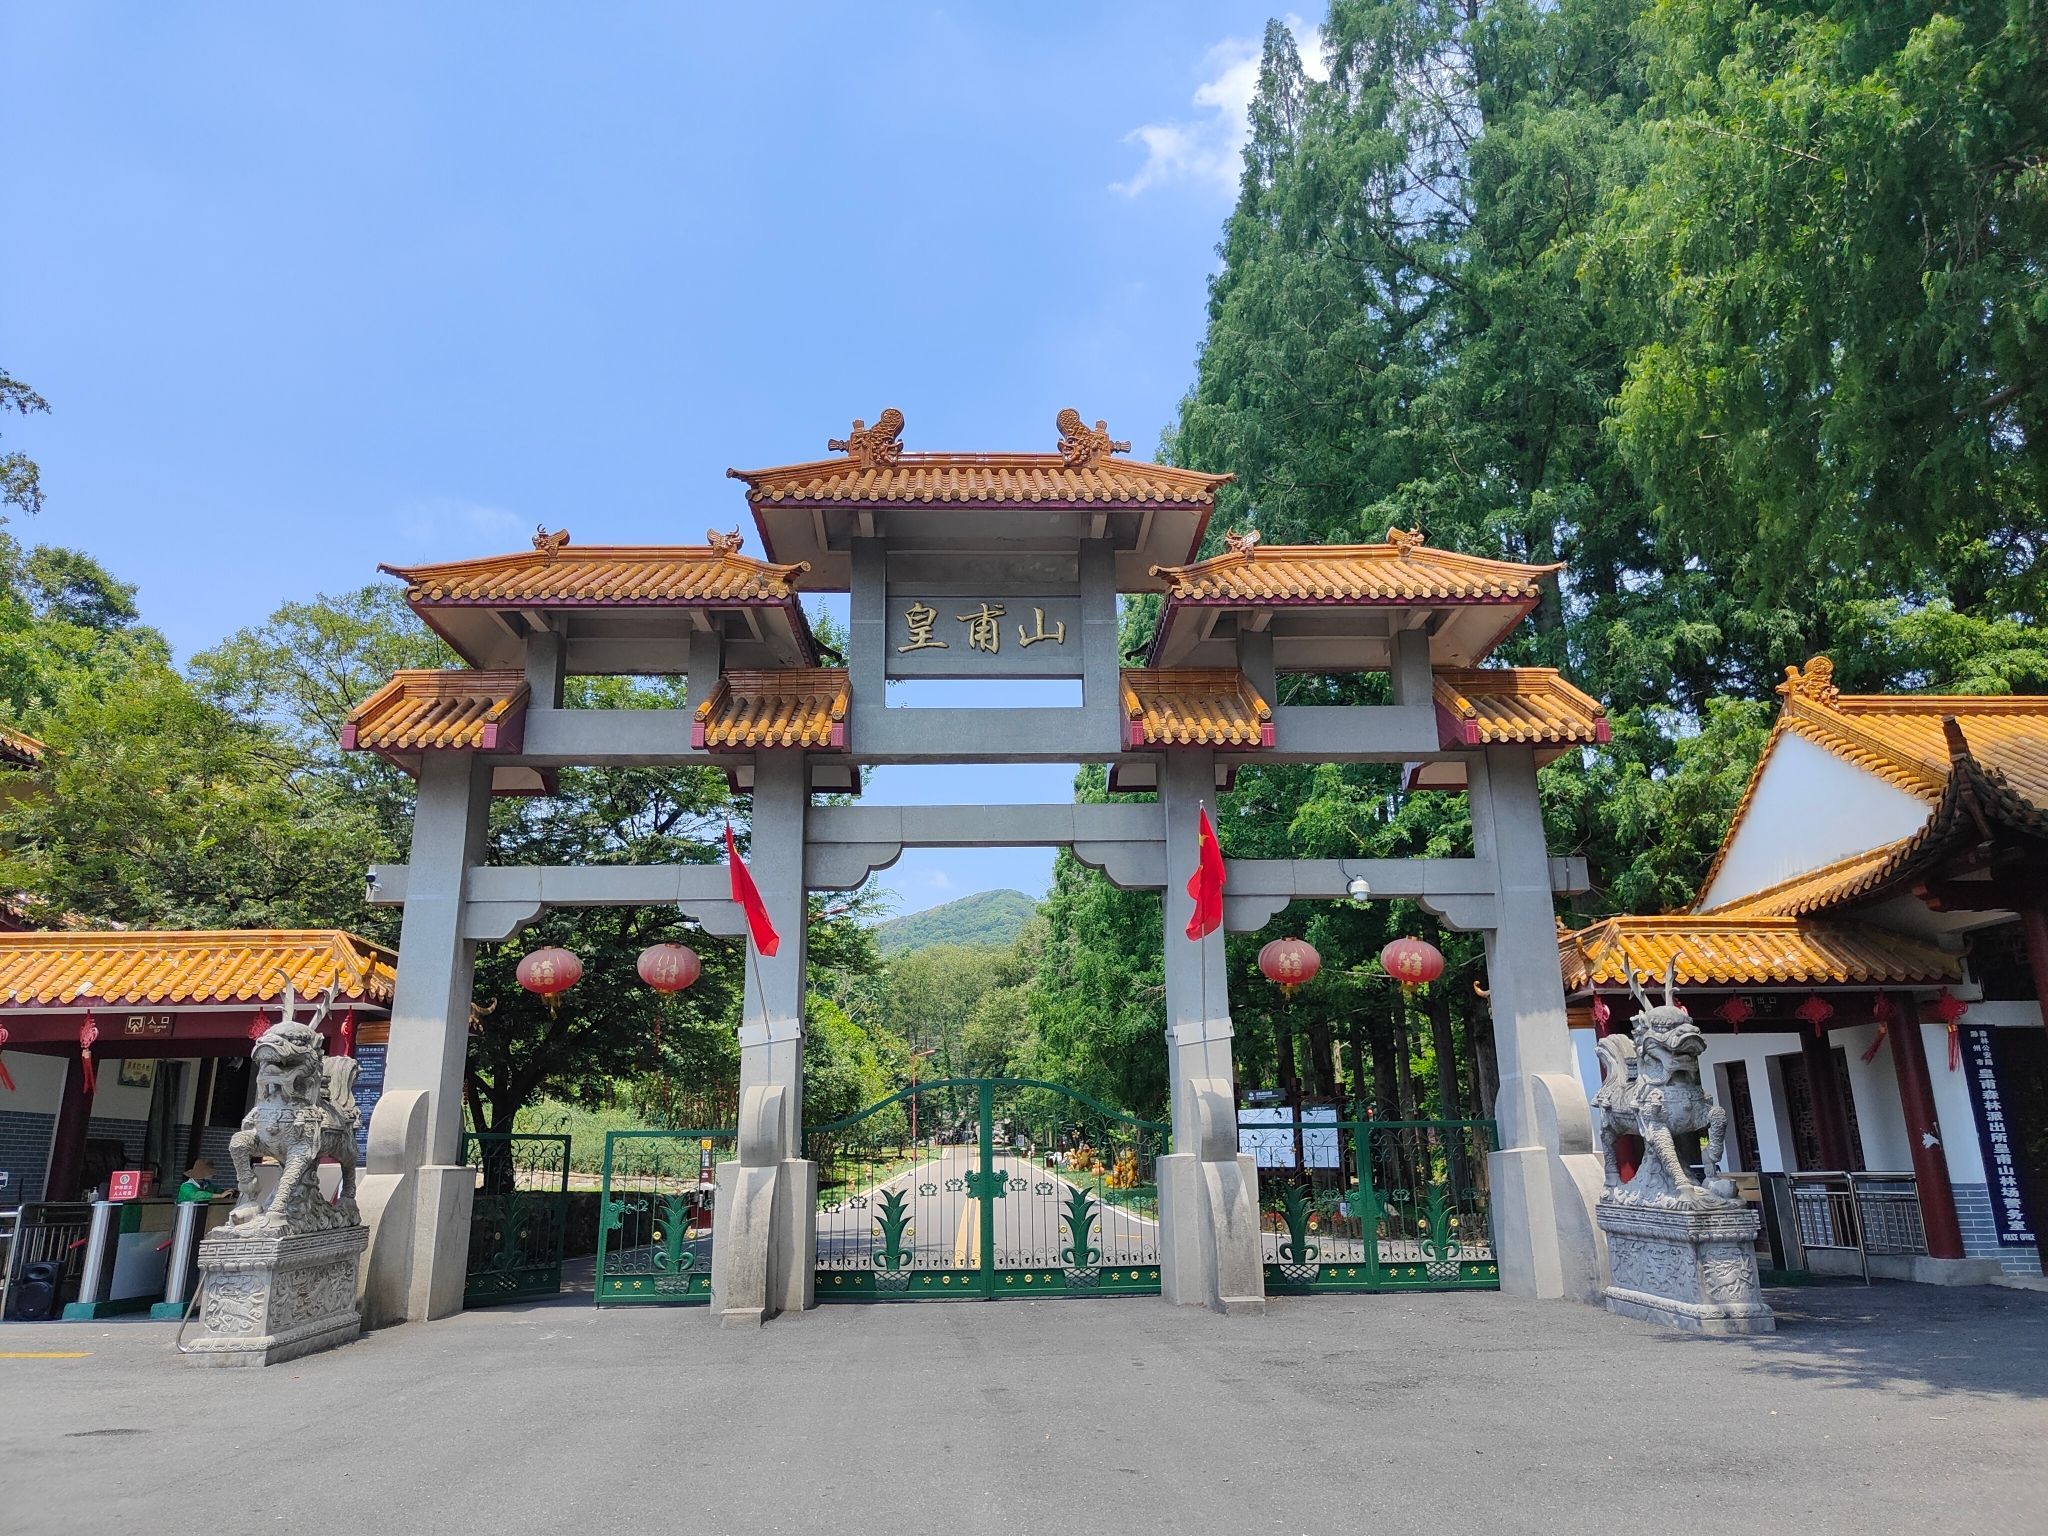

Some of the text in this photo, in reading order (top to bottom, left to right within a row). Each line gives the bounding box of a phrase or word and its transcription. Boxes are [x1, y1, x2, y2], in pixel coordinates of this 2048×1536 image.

[897, 600, 1067, 654] 皇甫山
[147, 1016, 170, 1025] 入口
[1979, 1030, 1994, 1066] 森林公安局
[1978, 1068, 2027, 1231] 皇甫森林派出所皇甫山林场警务室
[2002, 1232, 2036, 1241] POLICE OFFICE
